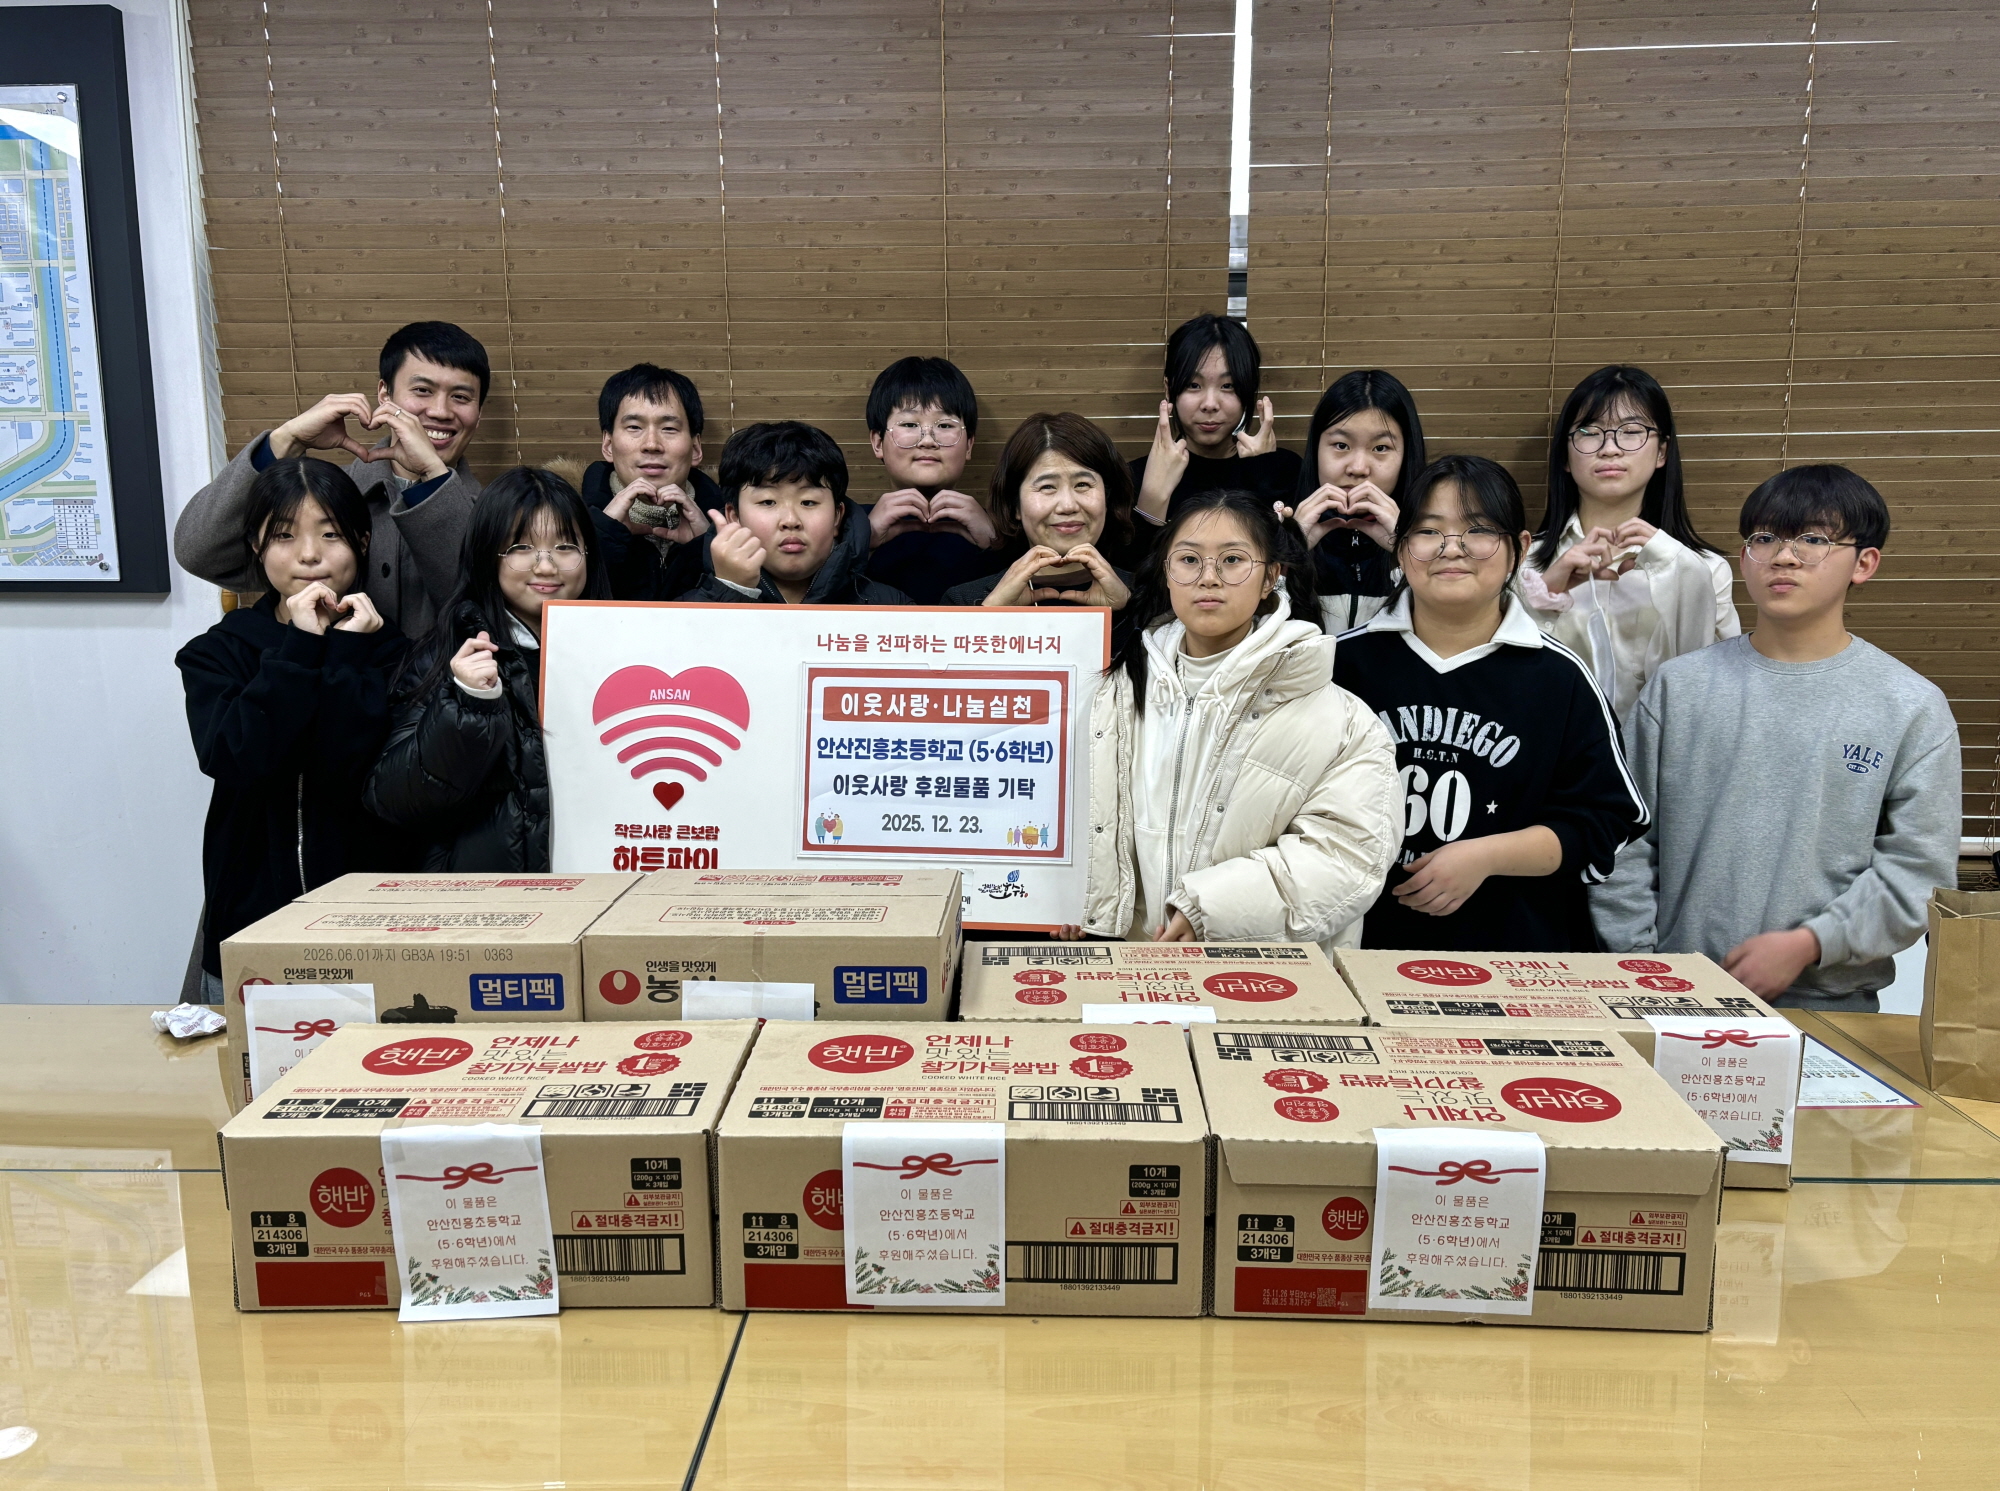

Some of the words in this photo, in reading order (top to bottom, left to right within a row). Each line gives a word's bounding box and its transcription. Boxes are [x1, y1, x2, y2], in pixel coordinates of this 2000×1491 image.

[817, 633, 870, 652] 나눔을
[876, 634, 947, 653] 전파하는
[954, 635, 1062, 654] 따뜻한에너지
[649, 688, 691, 701] ANSAN
[841, 692, 1032, 720] 이웃사랑·나눔실천
[1378, 705, 1521, 768] ANDIEGO
[816, 737, 964, 762] 안산진흥초등학교
[968, 739, 1054, 764] (5·6학년)
[1842, 744, 1884, 769] YALE
[833, 774, 909, 797] 이웃사랑
[915, 776, 990, 799] 후원물품
[998, 777, 1036, 800] 기탁
[1399, 764, 1472, 842] 60
[881, 813, 925, 833] 2025.
[931, 814, 952, 833] 12.
[958, 815, 983, 834] 23.
[614, 823, 673, 840] 작은사랑
[676, 824, 721, 841] 큰보람
[612, 845, 719, 872] 하트파이
[303, 948, 396, 963] 2026.06.01까지
[401, 948, 436, 962] GB3A
[440, 948, 471, 962] 19:51
[484, 948, 514, 961] 0363
[645, 960, 680, 973] 인생을
[682, 960, 717, 973] 맛있게
[1489, 960, 1569, 971] 언제나
[283, 967, 317, 980] 인생을
[319, 967, 354, 980] 맛있게
[1074, 971, 1193, 982] 찰기가득쌀밥
[843, 971, 919, 999] 멀티팩
[1505, 978, 1630, 989] 찰기가득쌀밥
[478, 977, 556, 1006] 멀티팩
[1120, 991, 1201, 1002] 언제나
[490, 1035, 580, 1048] 언제나
[925, 1034, 1014, 1048] 언제나
[480, 1049, 568, 1061] 맛있는
[926, 1048, 1012, 1061] 맛있는
[466, 1061, 608, 1075] 찰기가득쌀밥
[921, 1061, 1060, 1075] 찰기가득쌀밥
[1701, 1056, 1711, 1067] 이
[1716, 1057, 1748, 1069] 물품은
[1339, 1074, 1485, 1091] 찰기가득쌀밥
[1681, 1073, 1767, 1087] 안산진흥초등학교
[357, 1098, 391, 1106] 10개
[833, 1098, 865, 1106] 10개
[1395, 1090, 1493, 1105] 맛있는
[1686, 1092, 1758, 1104] (5·6학년)에서
[1403, 1105, 1507, 1122] 언제나
[644, 1159, 669, 1170] 10개
[633, 1174, 653, 1182] (200g
[1143, 1166, 1167, 1178] 10개
[1131, 1181, 1151, 1189] (200g
[900, 1188, 911, 1200] 이
[917, 1188, 953, 1200] 물품은
[445, 1198, 456, 1209] 이
[462, 1196, 498, 1210] 물품은
[1435, 1194, 1447, 1207] 이
[1453, 1195, 1490, 1209] 물품은
[594, 1213, 680, 1228] 절대충격금지!
[879, 1207, 975, 1221] 안산진흥초등학교
[1411, 1213, 1510, 1229] 안산진흥초등학교
[1544, 1213, 1562, 1226] 0개
[426, 1214, 522, 1232] 안산진흥초등학교
[1089, 1221, 1175, 1236] 절대충격금지!
[257, 1229, 303, 1241] 214306
[747, 1231, 794, 1242] 214306
[888, 1228, 967, 1242] (5·6학년)에서
[1242, 1233, 1289, 1245] 214306
[1418, 1233, 1500, 1249] (5·6학년)에서
[1599, 1230, 1681, 1246] 절대충격금지!
[266, 1243, 297, 1255] 3개입
[437, 1235, 516, 1250] (5·6학년)에서
[756, 1245, 787, 1257] 3개입
[879, 1249, 978, 1262] 후원해주셨습니다.
[1250, 1248, 1281, 1260] 3개입
[431, 1255, 529, 1269] 후원해주셨습니다.
[1406, 1252, 1508, 1268] 후원해주셨습니다.
[1059, 1284, 1121, 1292] 18801392133449
[1559, 1291, 1623, 1301] 18801392133449
